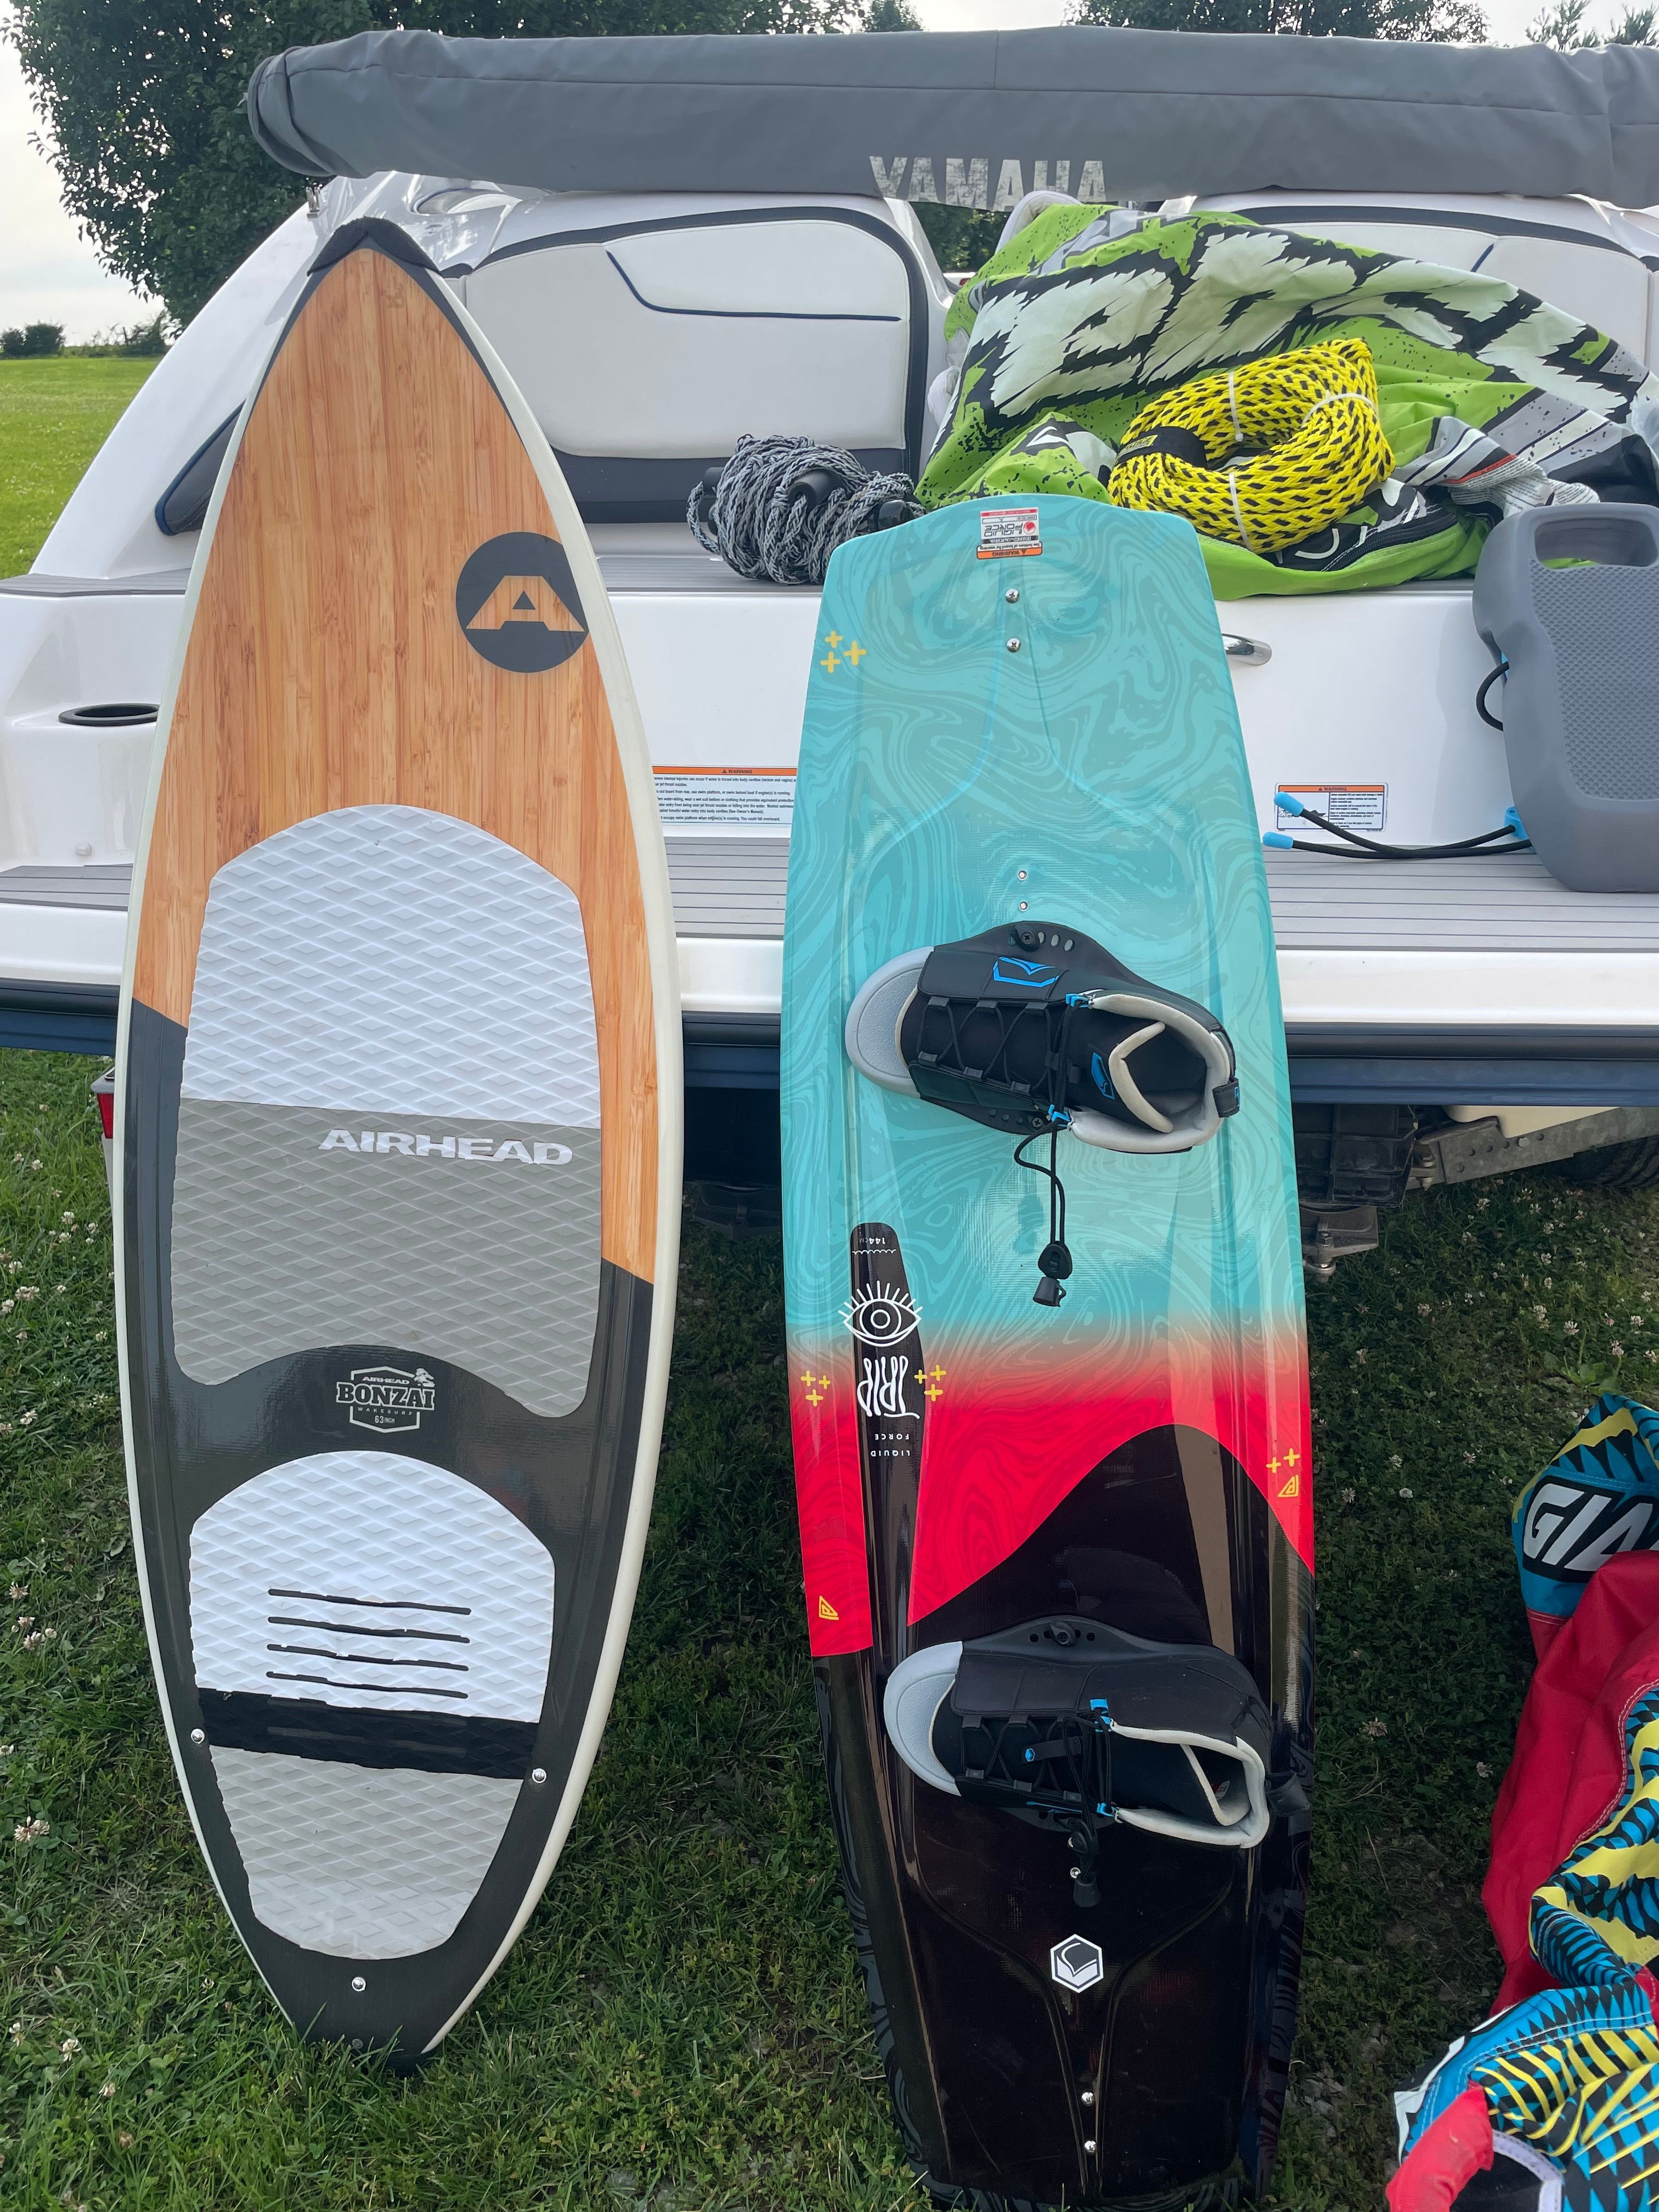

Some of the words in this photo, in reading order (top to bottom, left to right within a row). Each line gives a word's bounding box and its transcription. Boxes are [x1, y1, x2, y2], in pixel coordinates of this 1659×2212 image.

[869, 156, 1107, 212] YAMAHA
[984, 523, 1023, 531] FORCE
[318, 1128, 573, 1165] AIRHEAD
[336, 1381, 435, 1410] BONZAI
[362, 1376, 410, 1385] AIRHEAD
[856, 1355, 920, 1419] TRIP
[357, 1407, 413, 1415] WAKESURF
[1523, 1483, 1659, 1571] GIA
